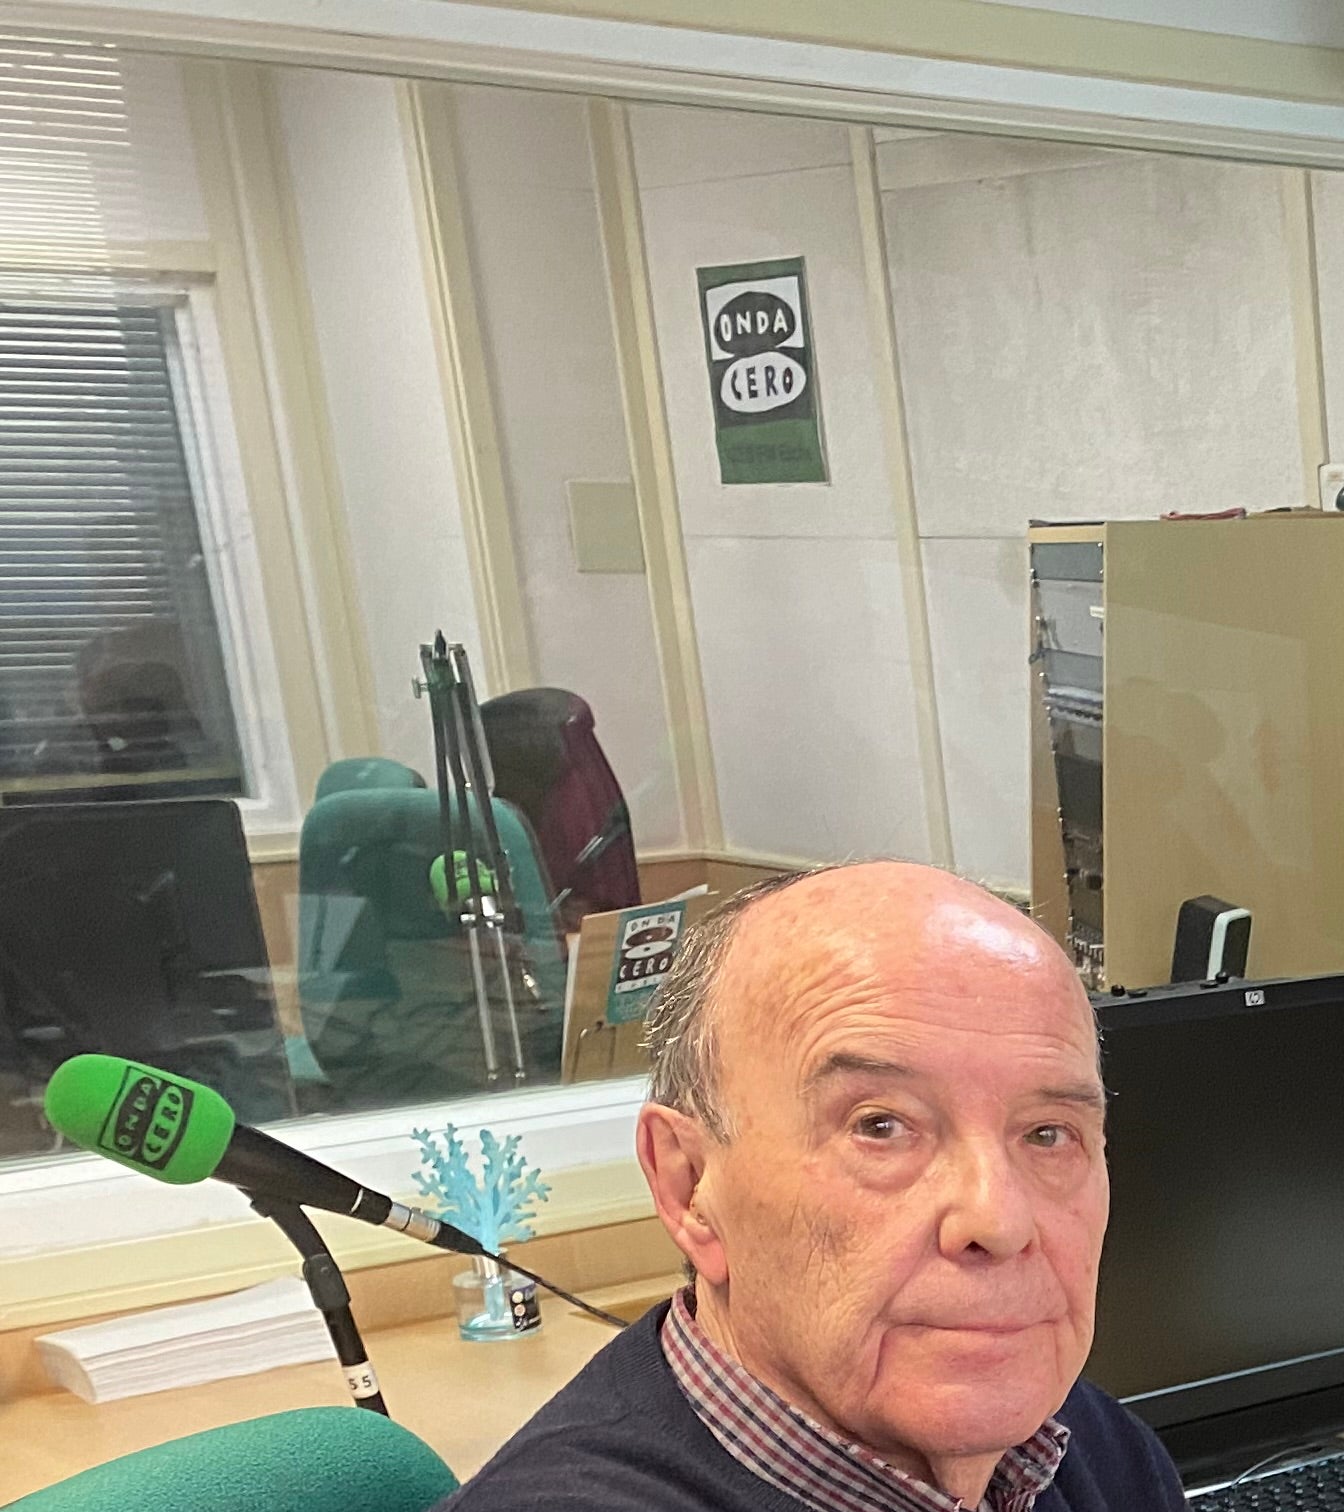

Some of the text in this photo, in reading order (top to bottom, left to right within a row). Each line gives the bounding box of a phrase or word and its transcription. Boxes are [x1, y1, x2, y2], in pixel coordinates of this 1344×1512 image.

[720, 308, 789, 342] ONDA
[730, 365, 794, 401] CERO
[619, 957, 669, 979] CERO
[118, 1082, 154, 1146] ONDA
[145, 1092, 181, 1154] CERO
